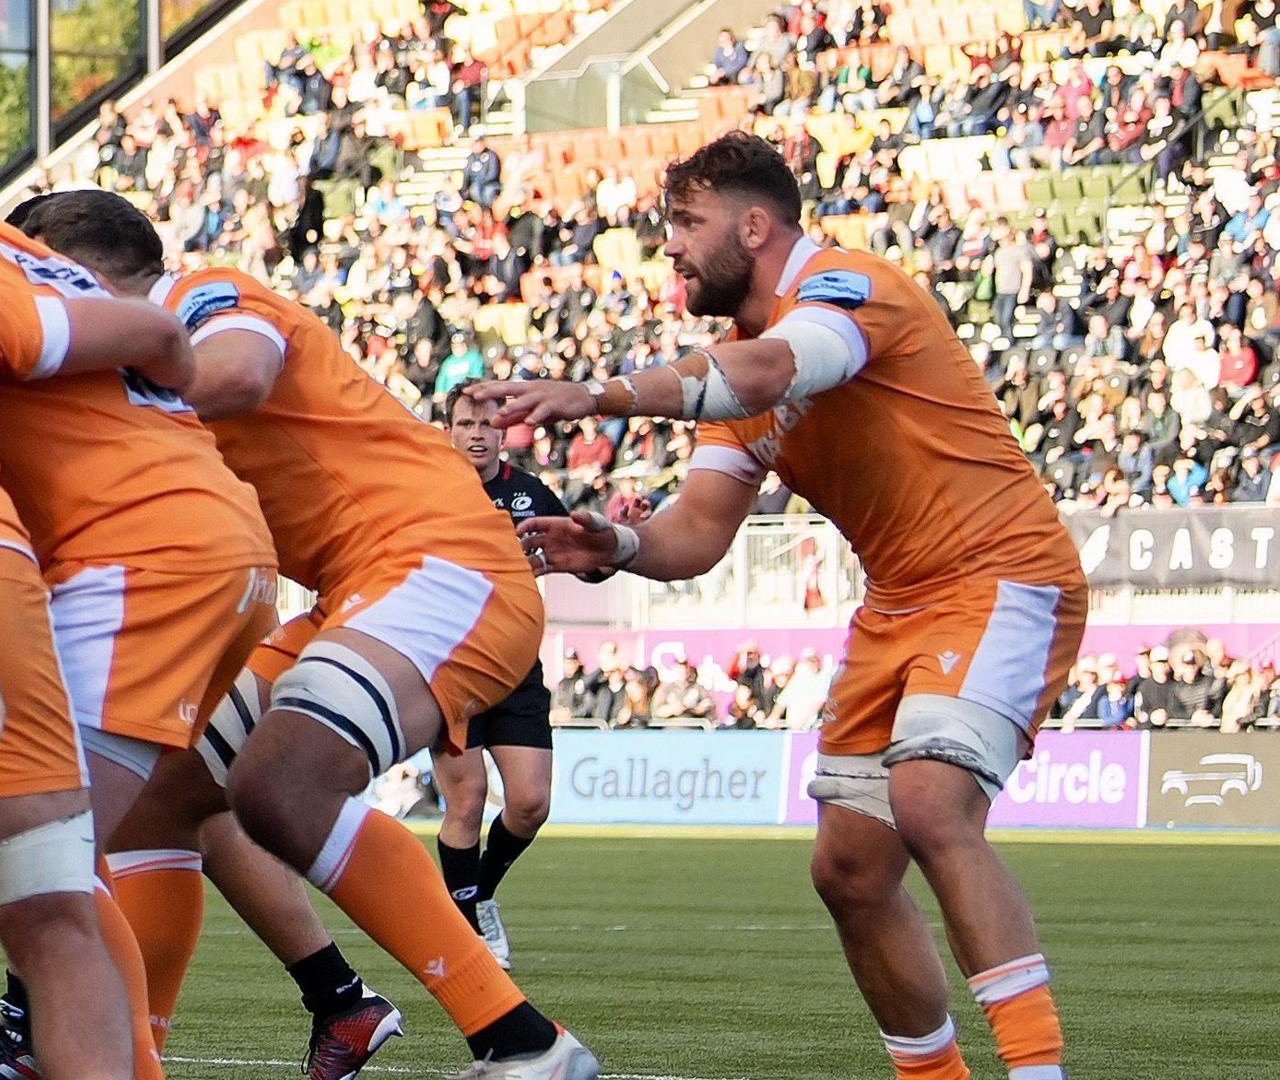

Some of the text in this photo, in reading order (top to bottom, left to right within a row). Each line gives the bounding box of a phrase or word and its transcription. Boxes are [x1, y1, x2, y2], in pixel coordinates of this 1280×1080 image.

[1128, 526, 1276, 571] CAST
[571, 755, 770, 811] Gallagher
[1007, 749, 1127, 805] Circle
